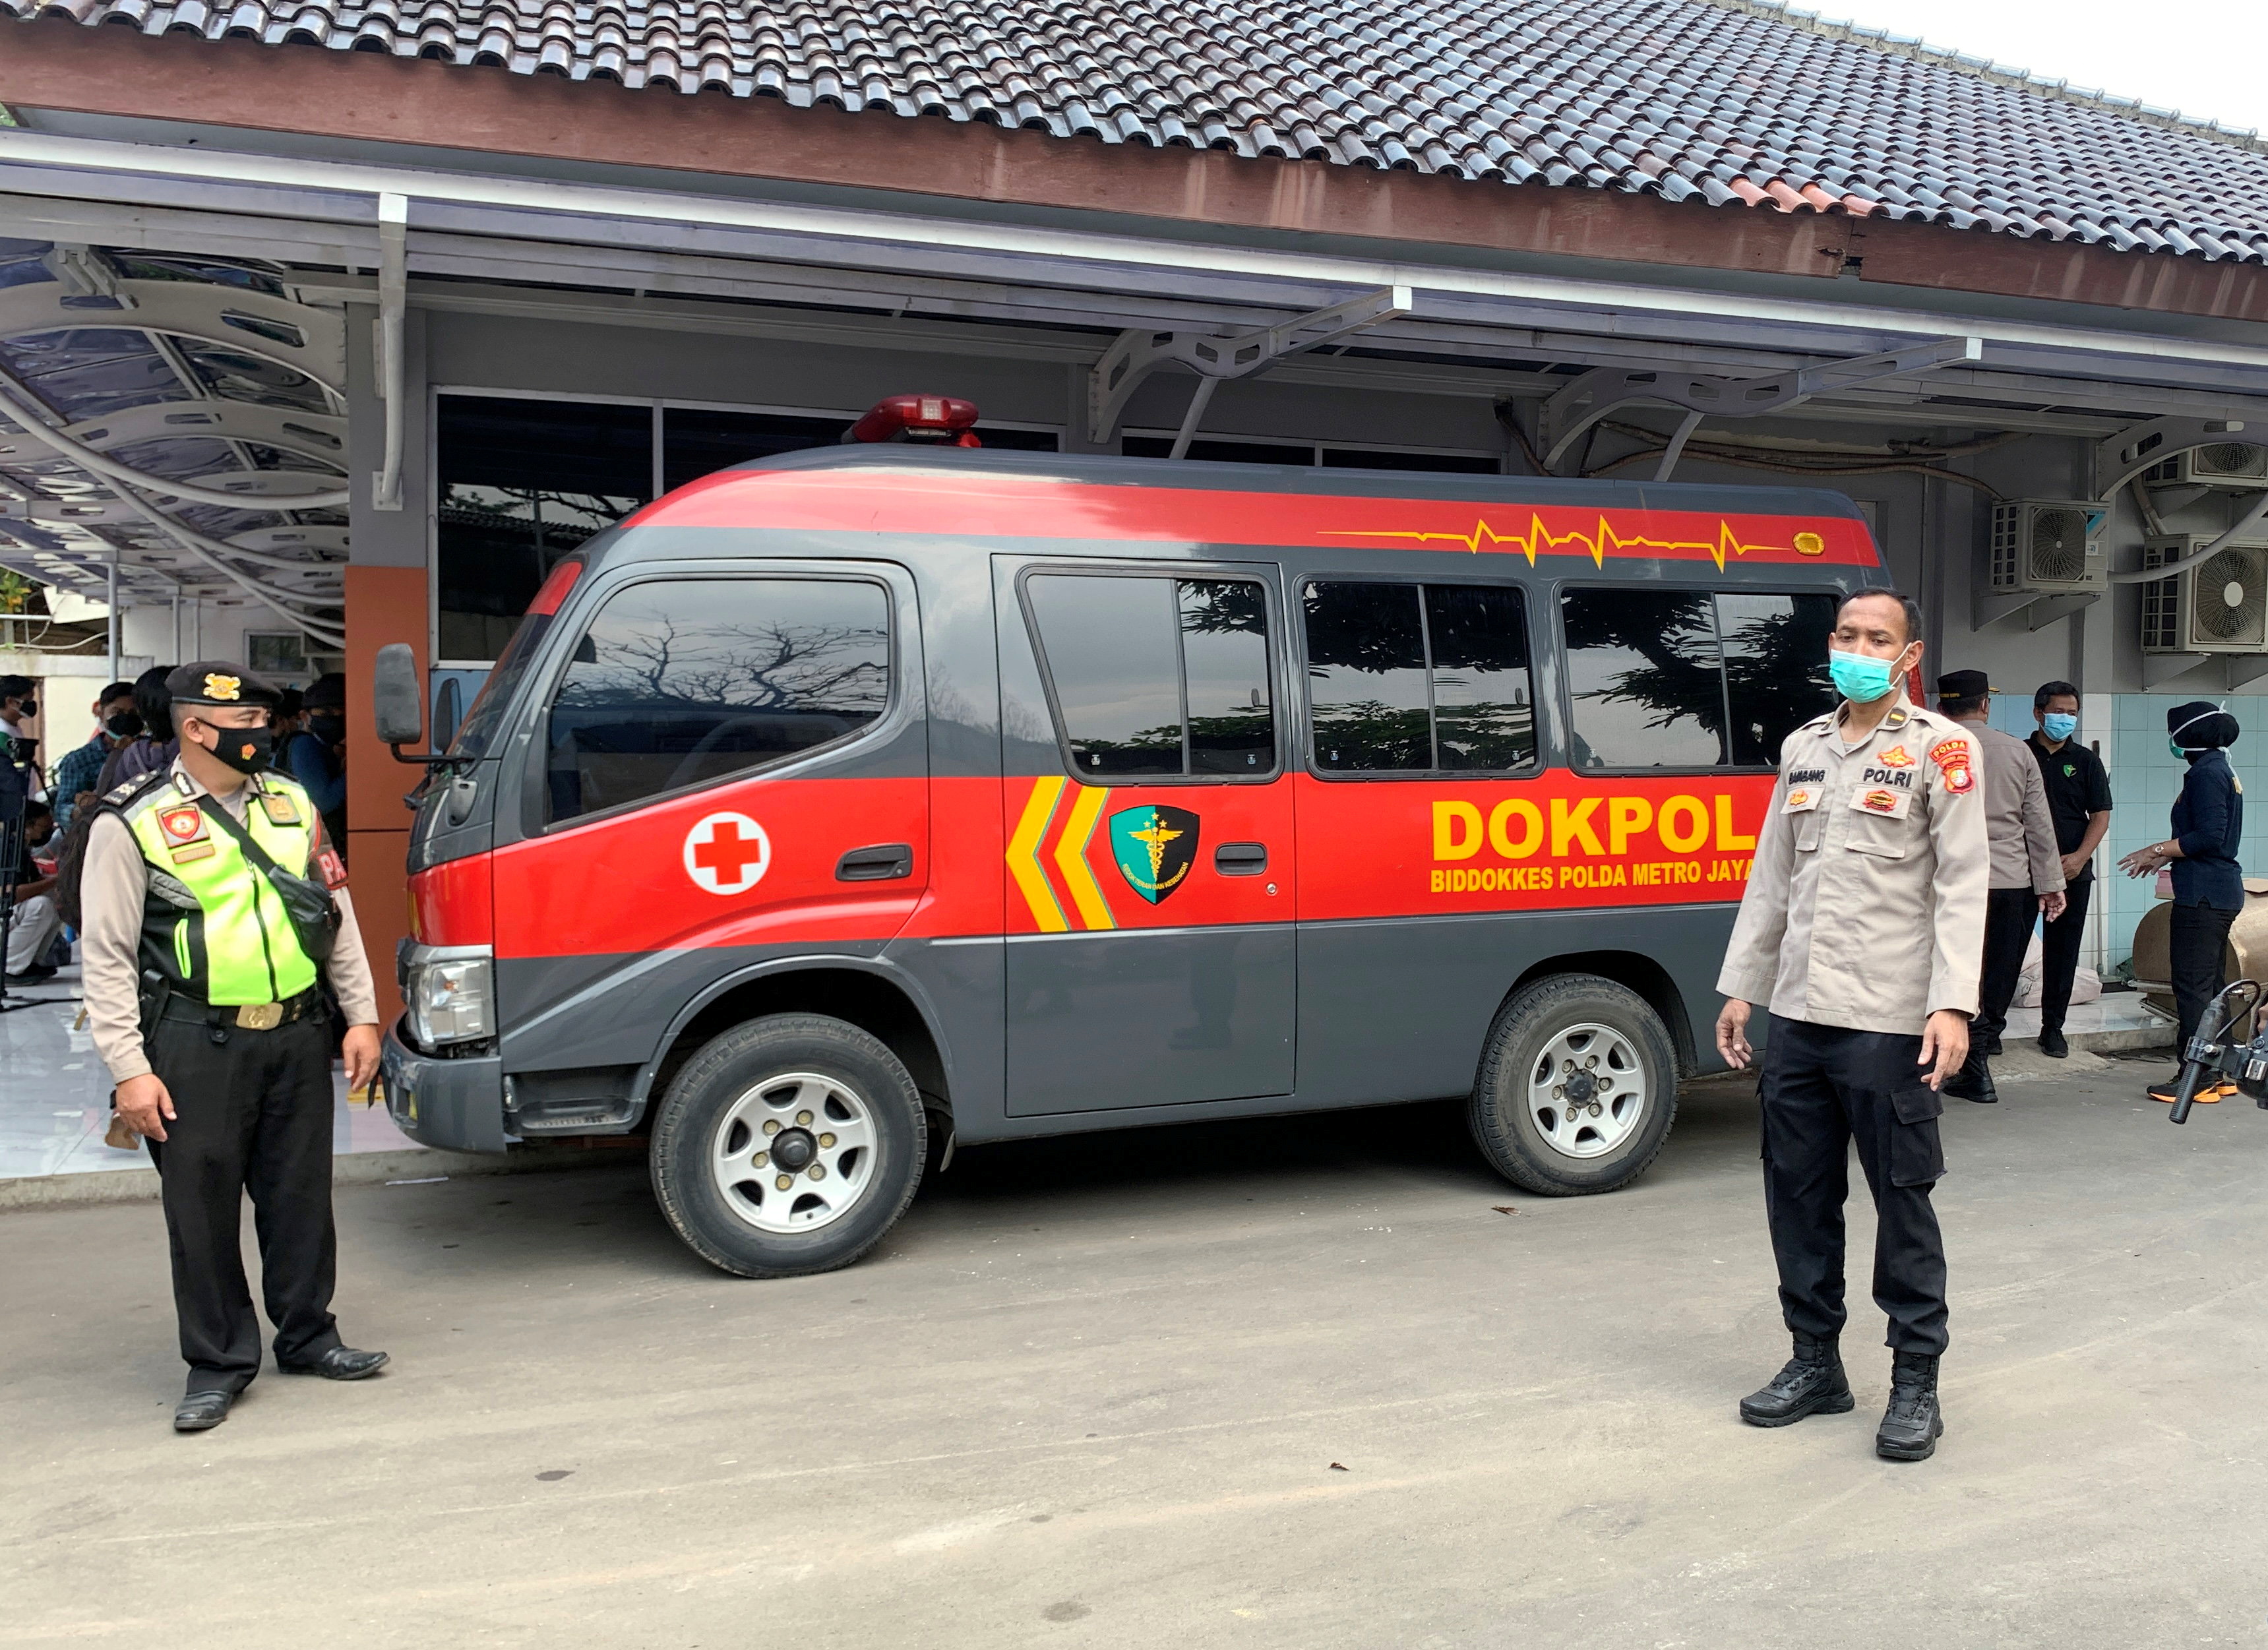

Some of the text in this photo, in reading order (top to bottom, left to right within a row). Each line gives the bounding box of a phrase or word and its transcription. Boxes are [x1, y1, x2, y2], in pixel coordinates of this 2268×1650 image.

[1933, 741, 1965, 758] POLDA
[1863, 768, 1913, 787] POLRI
[1432, 795, 1756, 861] DOKPOL
[1165, 862, 1188, 888] KESEHATAN
[1430, 859, 1754, 893] BIDDOKKES POLDA METRO JAYA
